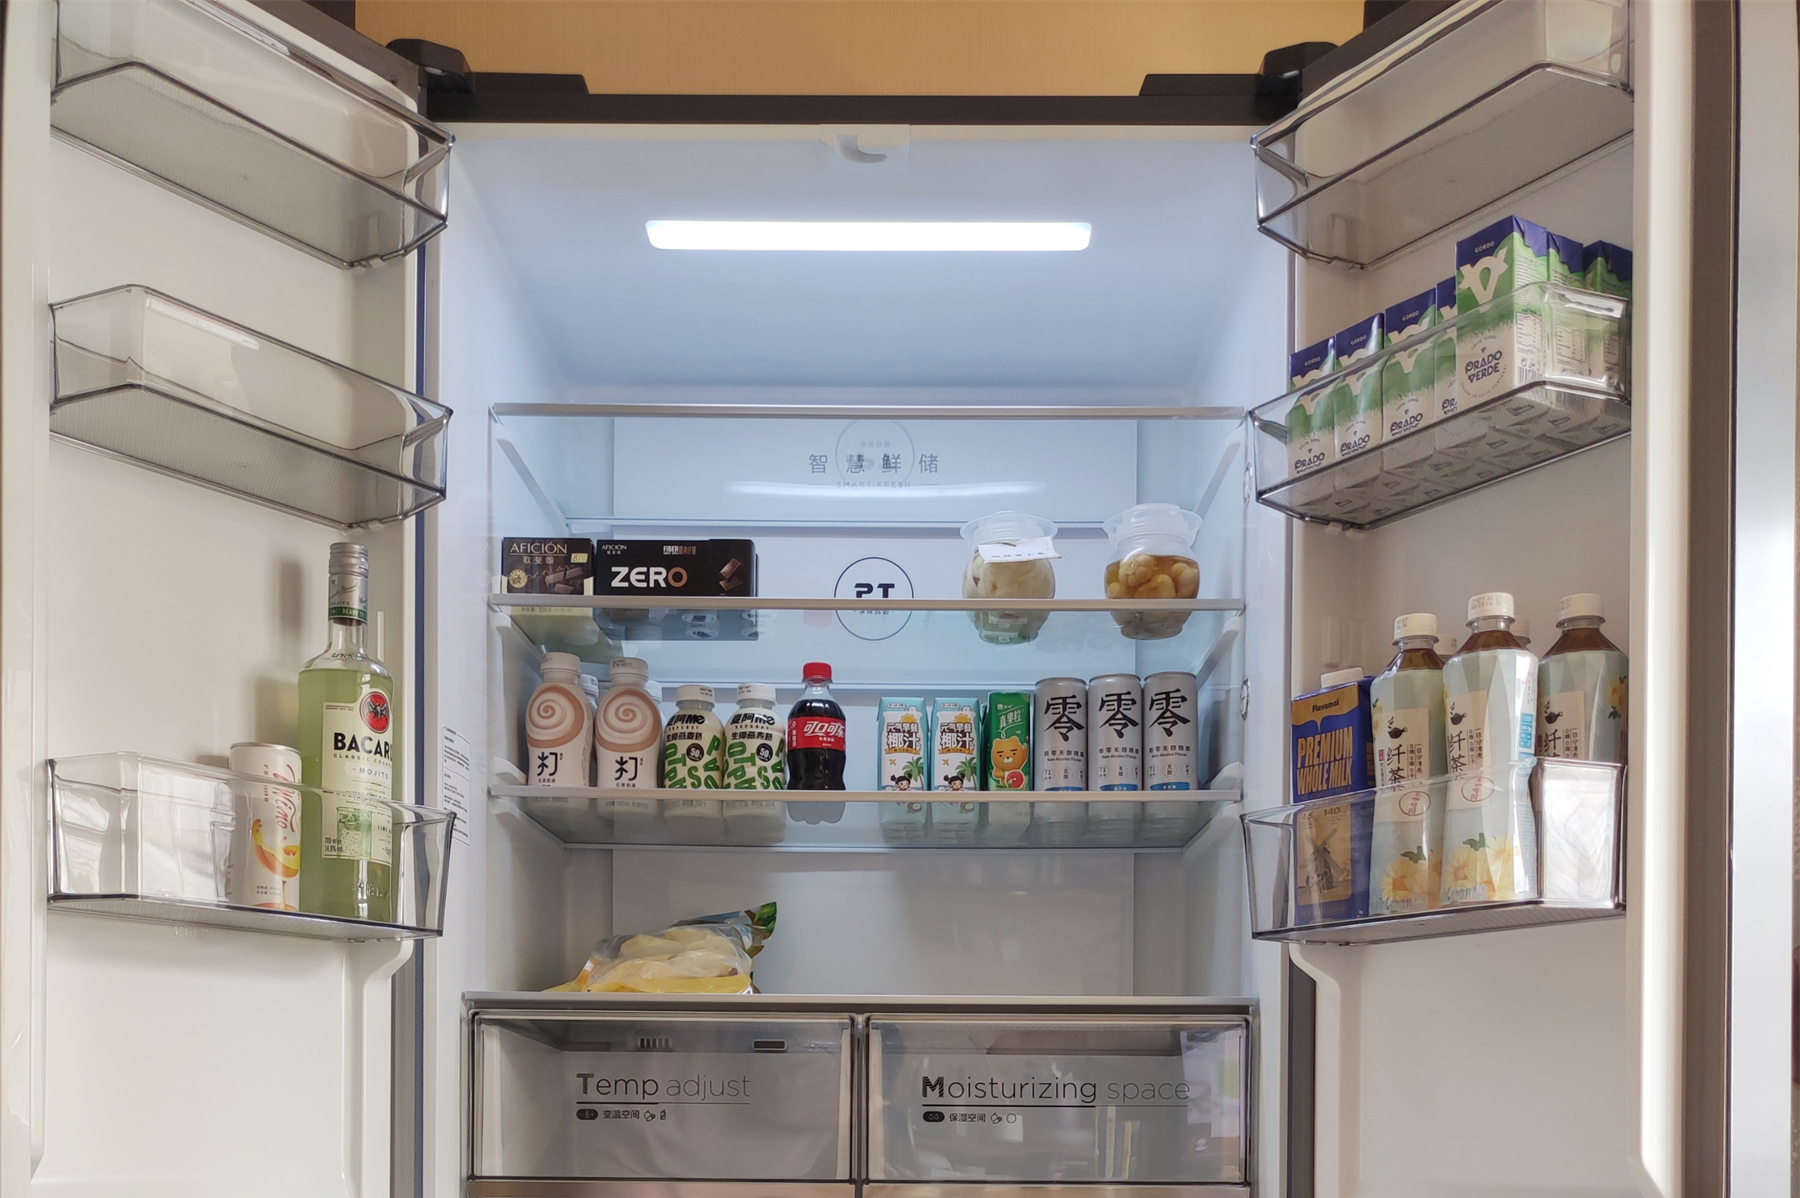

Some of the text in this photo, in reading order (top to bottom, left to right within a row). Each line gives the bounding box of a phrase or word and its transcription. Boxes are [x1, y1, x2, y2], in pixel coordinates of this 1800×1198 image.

[1474, 241, 1495, 253] GORDO
[1401, 310, 1420, 322] GORDO
[1350, 335, 1367, 346] GORDO
[1304, 356, 1321, 367] GORDO
[1465, 350, 1502, 374] PRADO
[1468, 362, 1500, 383] VERDE
[1390, 412, 1423, 433] PRADO
[1340, 434, 1371, 454] PRADO
[808, 453, 939, 474] 智慧鲜储
[1294, 452, 1326, 471] PRADO
[836, 481, 911, 489] SMART FRESH
[510, 541, 567, 554] AFICIÓN
[611, 566, 688, 588] ZERO
[999, 709, 1022, 729] 真果粒
[1044, 694, 1085, 742] 零
[1098, 690, 1140, 739] 零
[1149, 688, 1191, 737] 零
[803, 720, 845, 739] 可口可乐
[886, 732, 921, 749] 椰汁
[940, 732, 975, 749] 椰汁
[1297, 726, 1354, 769] PREMIUM
[333, 753, 370, 762] CLASSIC
[359, 767, 389, 780] MOJITO
[1297, 762, 1329, 796] WHOLE
[1328, 757, 1353, 789] MILK
[576, 1073, 750, 1100] Temp adjust
[922, 1076, 1190, 1104] Moisturizing space
[603, 1109, 640, 1120] 变温空间
[949, 1112, 987, 1123] 保湿空间
